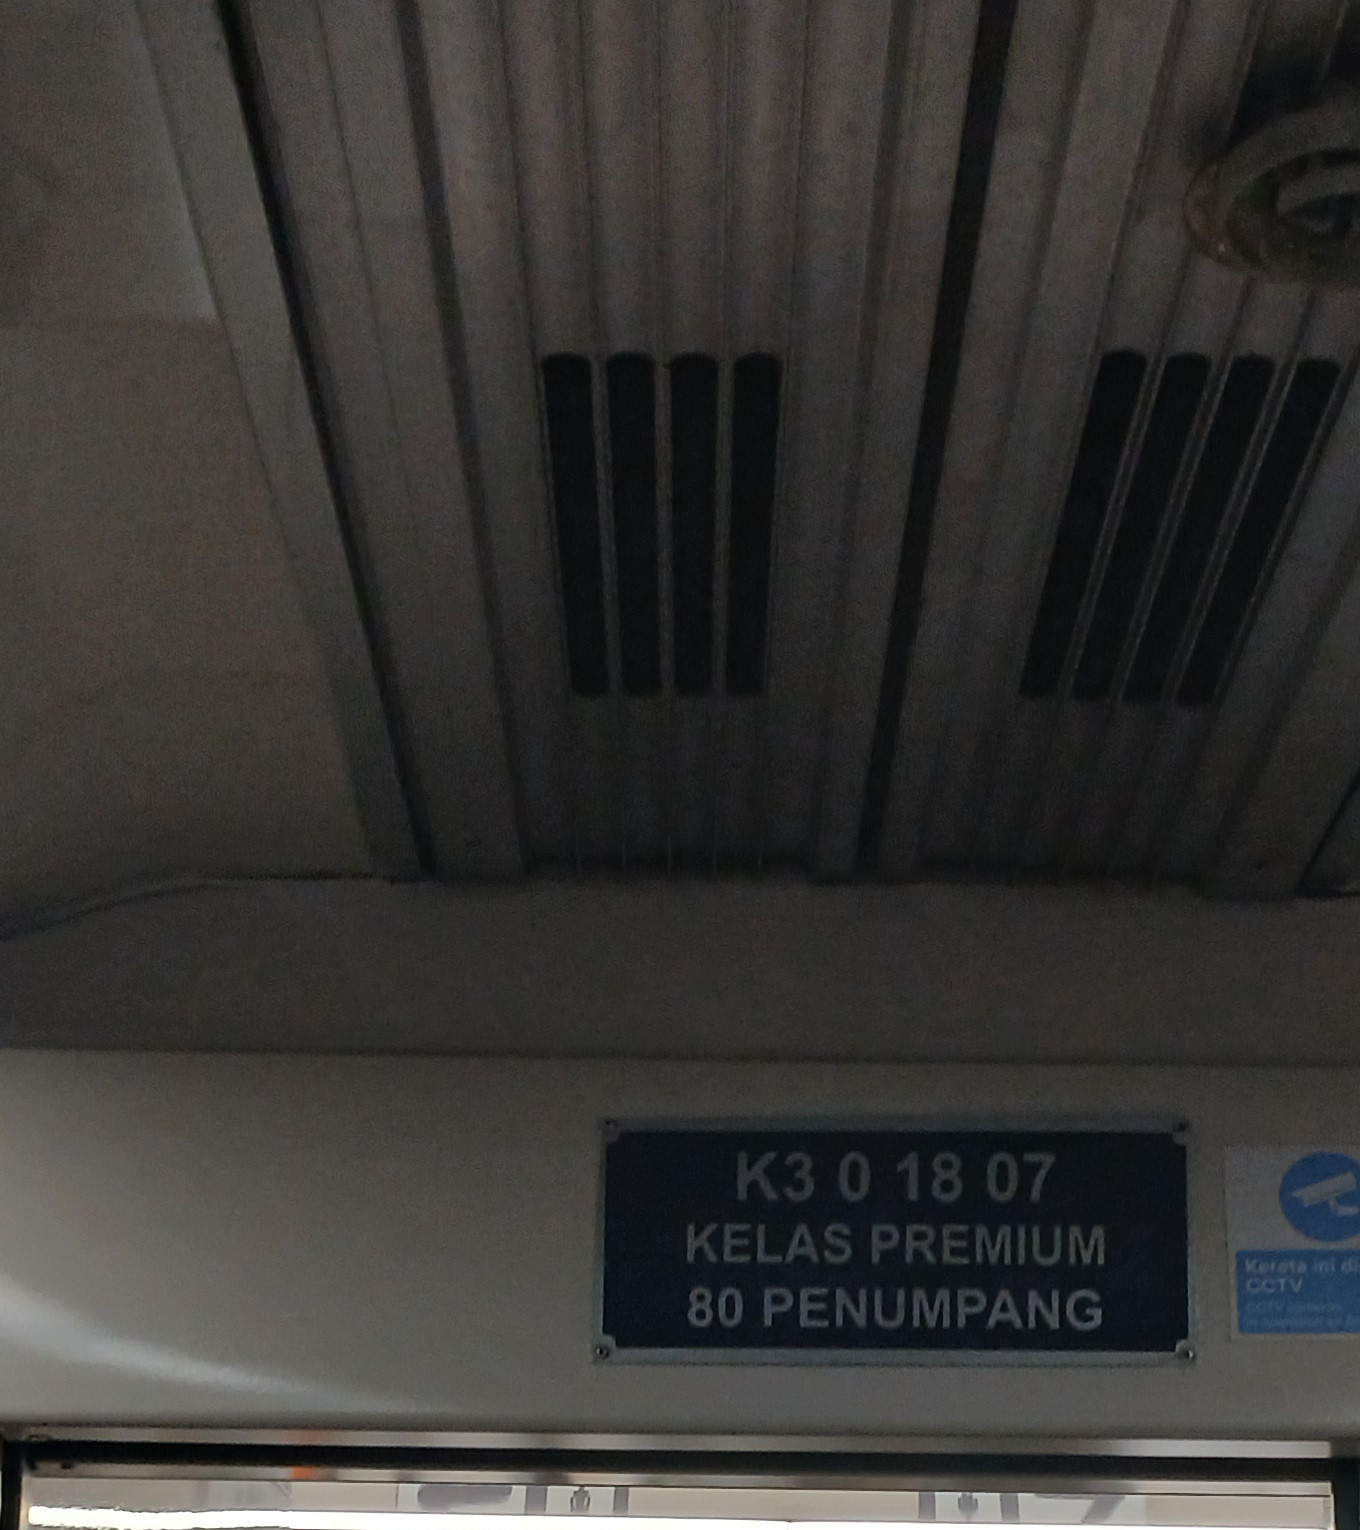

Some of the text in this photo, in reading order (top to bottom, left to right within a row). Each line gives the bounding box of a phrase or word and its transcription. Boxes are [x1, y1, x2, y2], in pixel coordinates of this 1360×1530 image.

[735, 1150, 1056, 1201] K3 0 18 07
[685, 1222, 1106, 1266] KELAS PREMIUM
[1245, 1258, 1307, 1274] Kereta
[1313, 1257, 1335, 1274] ini
[1245, 1278, 1303, 1293] CCTV
[687, 1287, 1105, 1330] 80 PENUMPANG
